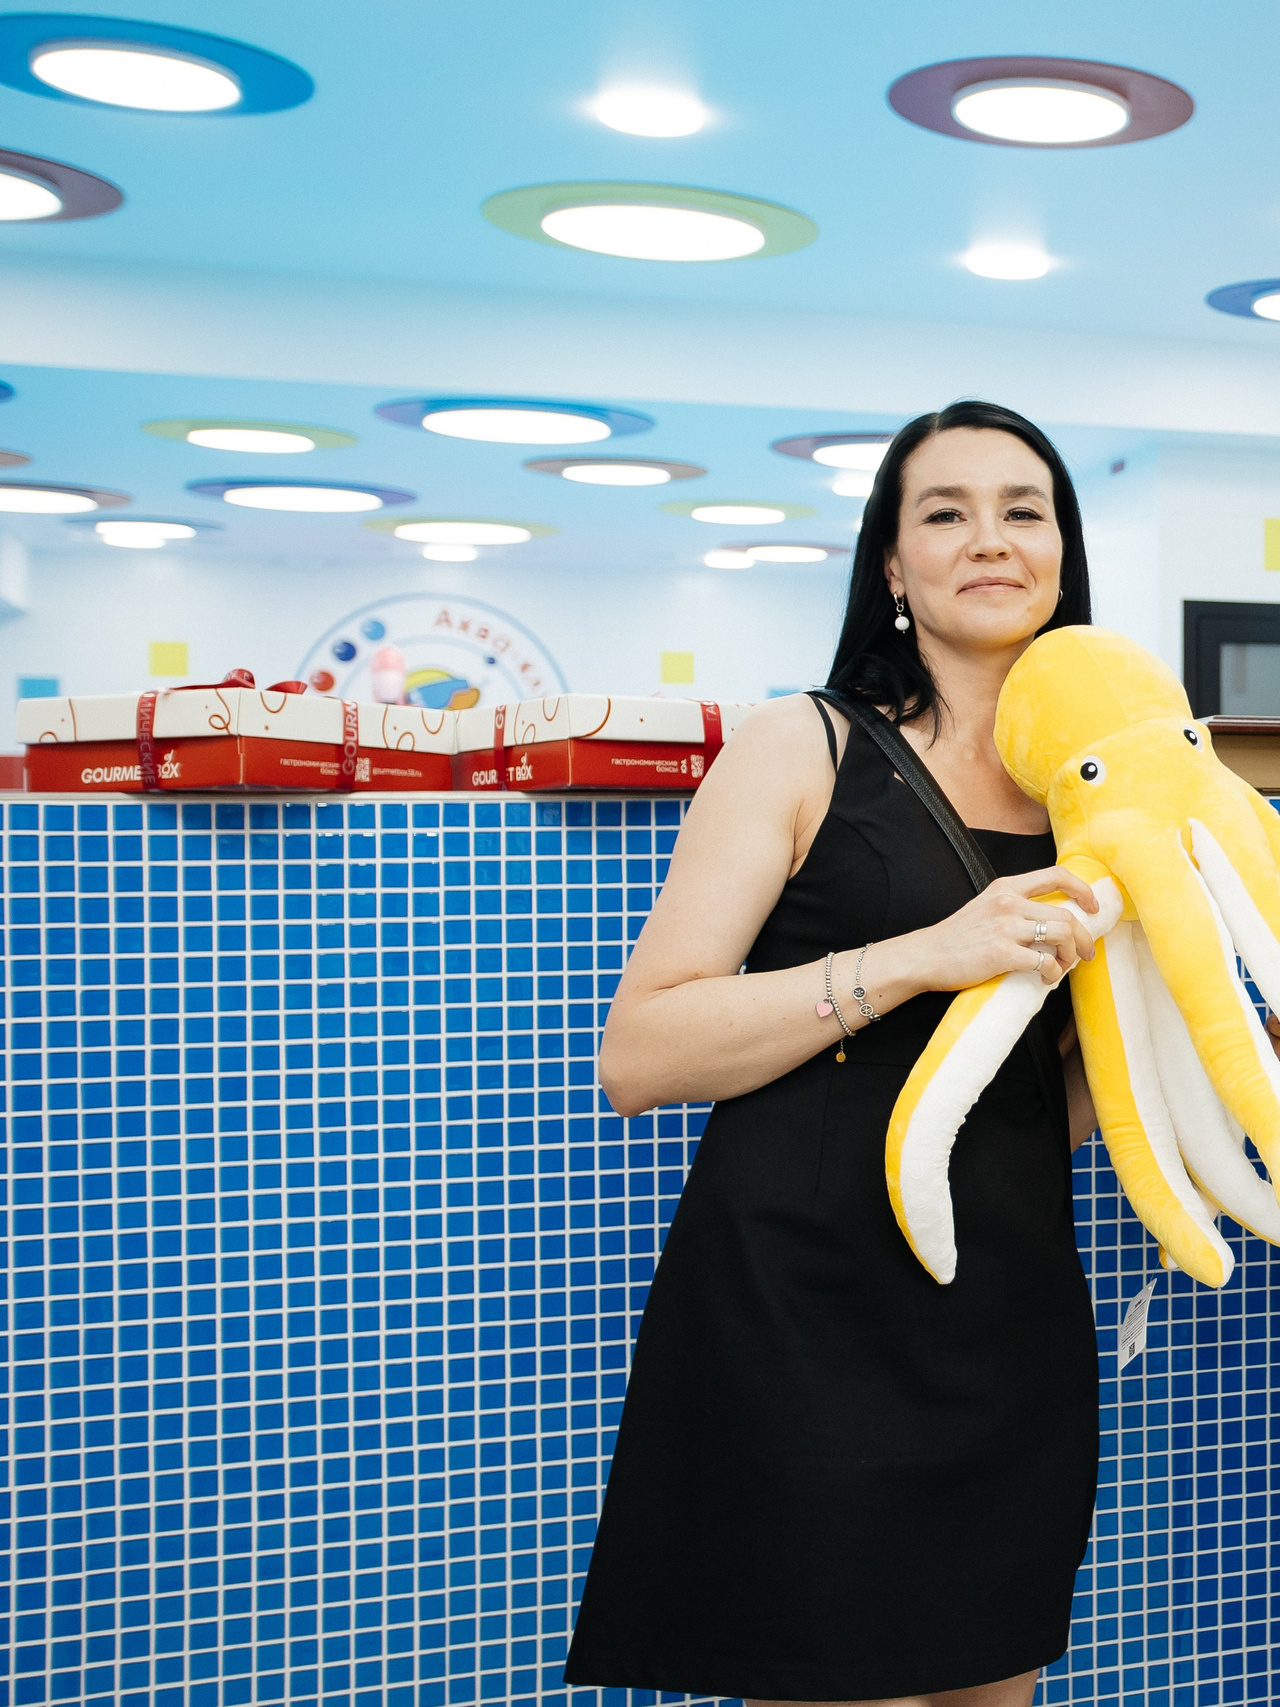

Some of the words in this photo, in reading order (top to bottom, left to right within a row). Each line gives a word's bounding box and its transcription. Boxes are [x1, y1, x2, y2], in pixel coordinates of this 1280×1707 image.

[611, 758, 678, 768] гастрономические
[656, 765, 679, 773] боксы
[81, 764, 143, 784] GOURME
[472, 766, 515, 786] GOURT
[515, 764, 533, 781] BOX
